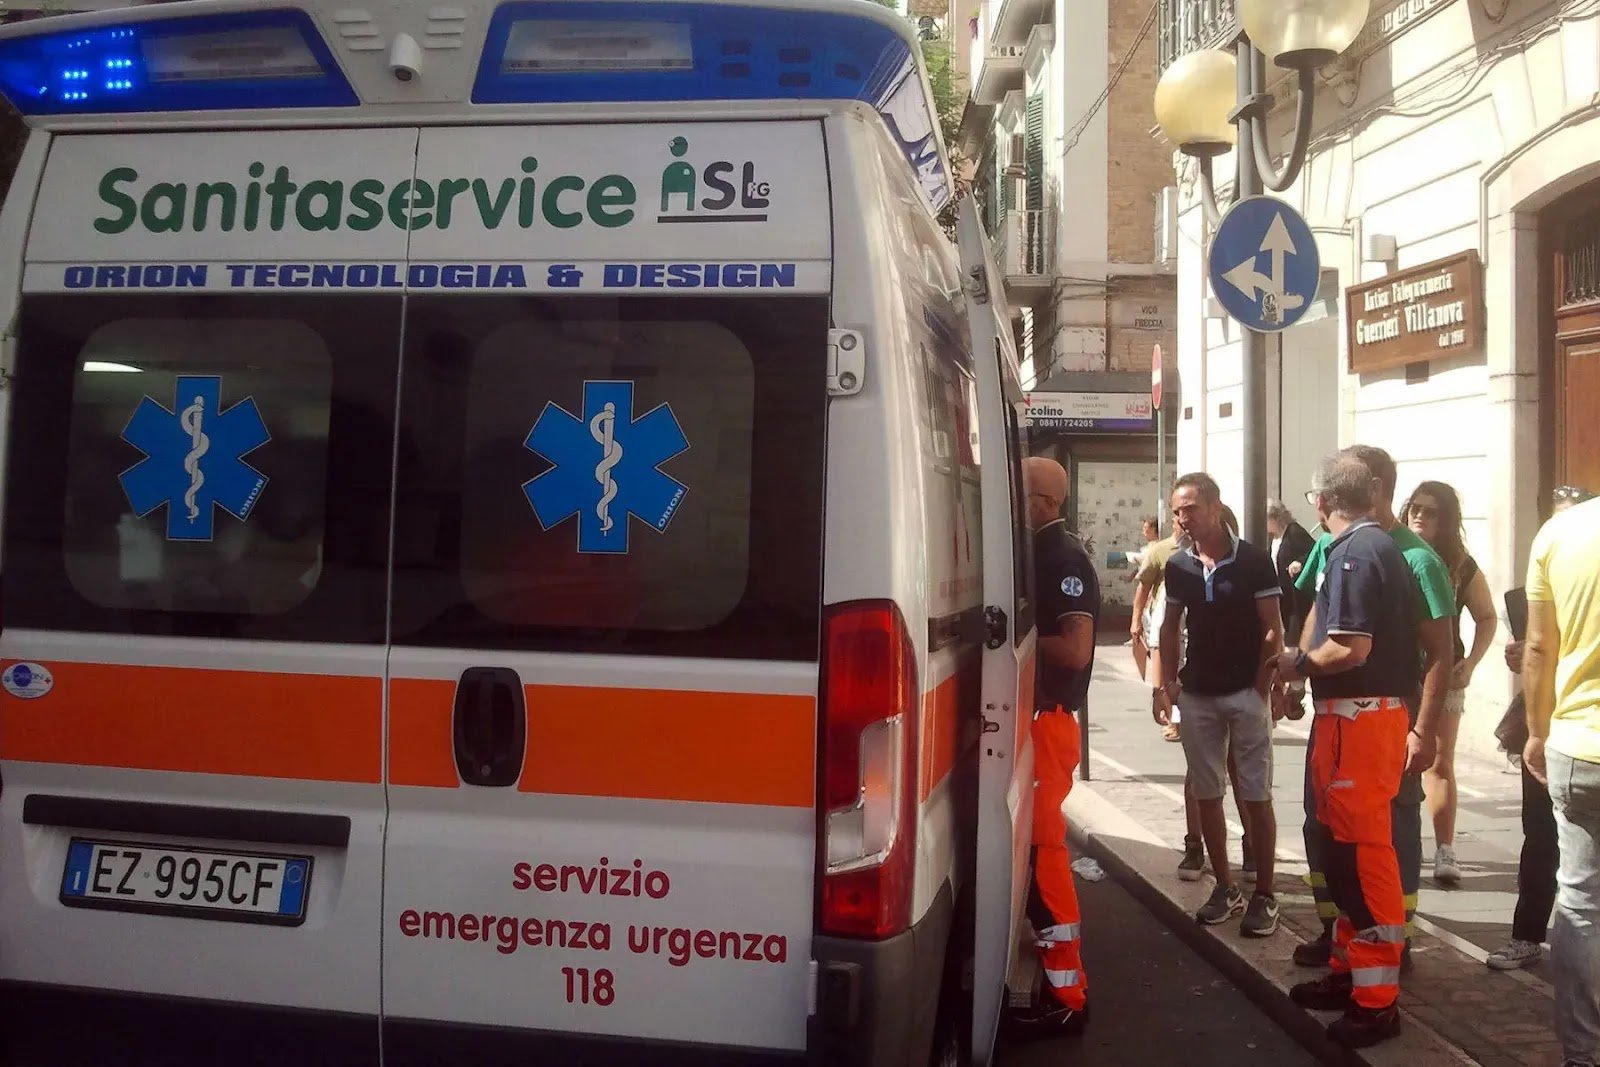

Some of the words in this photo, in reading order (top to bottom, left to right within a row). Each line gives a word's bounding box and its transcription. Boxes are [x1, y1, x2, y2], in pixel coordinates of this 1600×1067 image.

[94, 156, 636, 234] Sanitaservice
[64, 265, 208, 288] ORION
[226, 264, 527, 288] TECNOLOGIA
[547, 264, 583, 288] &
[603, 264, 796, 288] DESIGN
[1404, 301, 1464, 333] Villanova
[658, 489, 684, 527] ORION
[92, 850, 142, 895] EZ
[155, 855, 278, 906] 995CF
[513, 857, 670, 899] servizio
[400, 909, 611, 954] emergenza
[628, 925, 787, 966] urgenza
[561, 967, 616, 1006] 118
